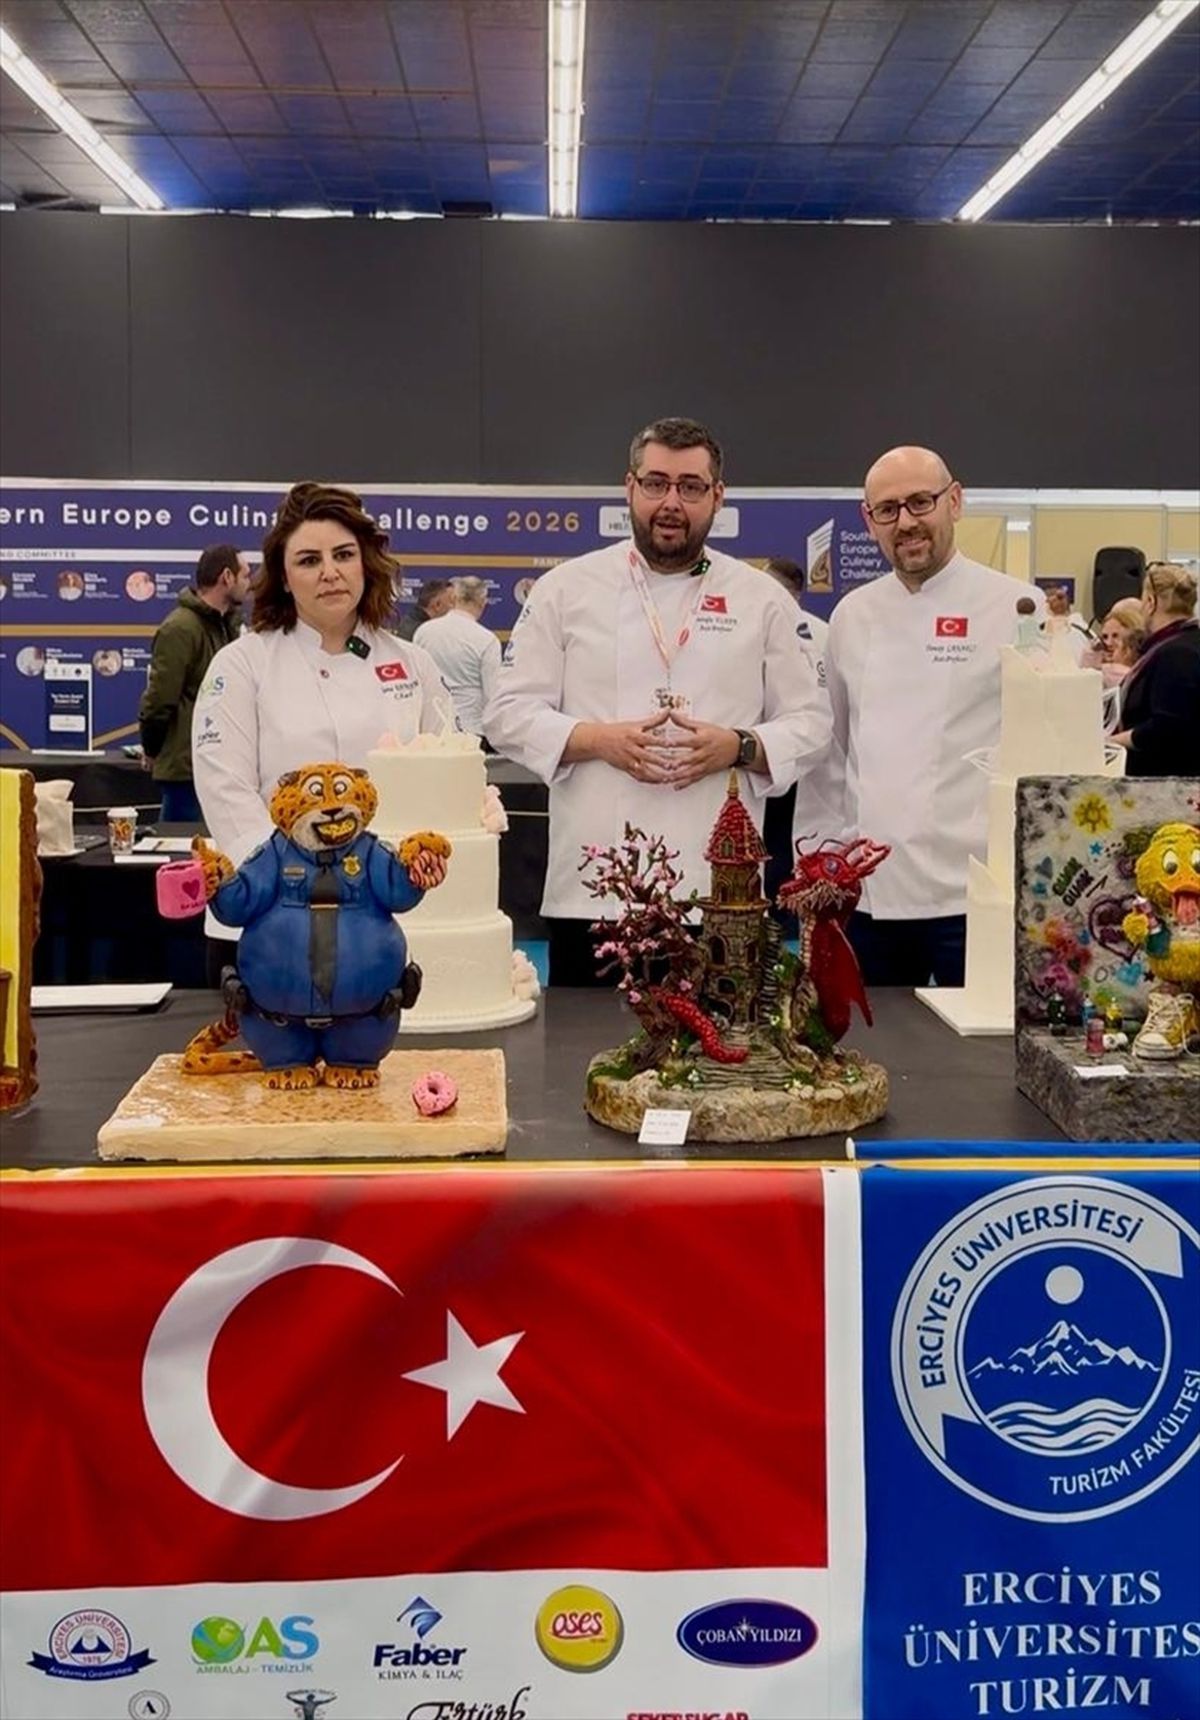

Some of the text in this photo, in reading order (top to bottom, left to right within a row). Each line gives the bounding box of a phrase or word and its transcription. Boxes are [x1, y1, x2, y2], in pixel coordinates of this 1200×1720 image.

[62, 503, 171, 530] Europe
[361, 507, 489, 536] allenge
[506, 511, 579, 532] 2026
[840, 543, 879, 555] Europe
[840, 556, 882, 568] Culinary
[916, 1199, 1144, 1389] ERCİYES ÜNİVERSİTESİ
[1050, 1369, 1200, 1495] TURİZM FAKÜLTESİ
[962, 1566, 1162, 1607] ERCİYES
[696, 1628, 802, 1646] ÇOBAN YILDIZI
[373, 1642, 467, 1667] Faber
[196, 1664, 250, 1675] AMBALAJ
[261, 1663, 314, 1674] TEMİZLİK
[378, 1669, 417, 1680] KİMYA
[422, 1670, 430, 1679] &
[969, 1668, 1151, 1715] TURİZM
